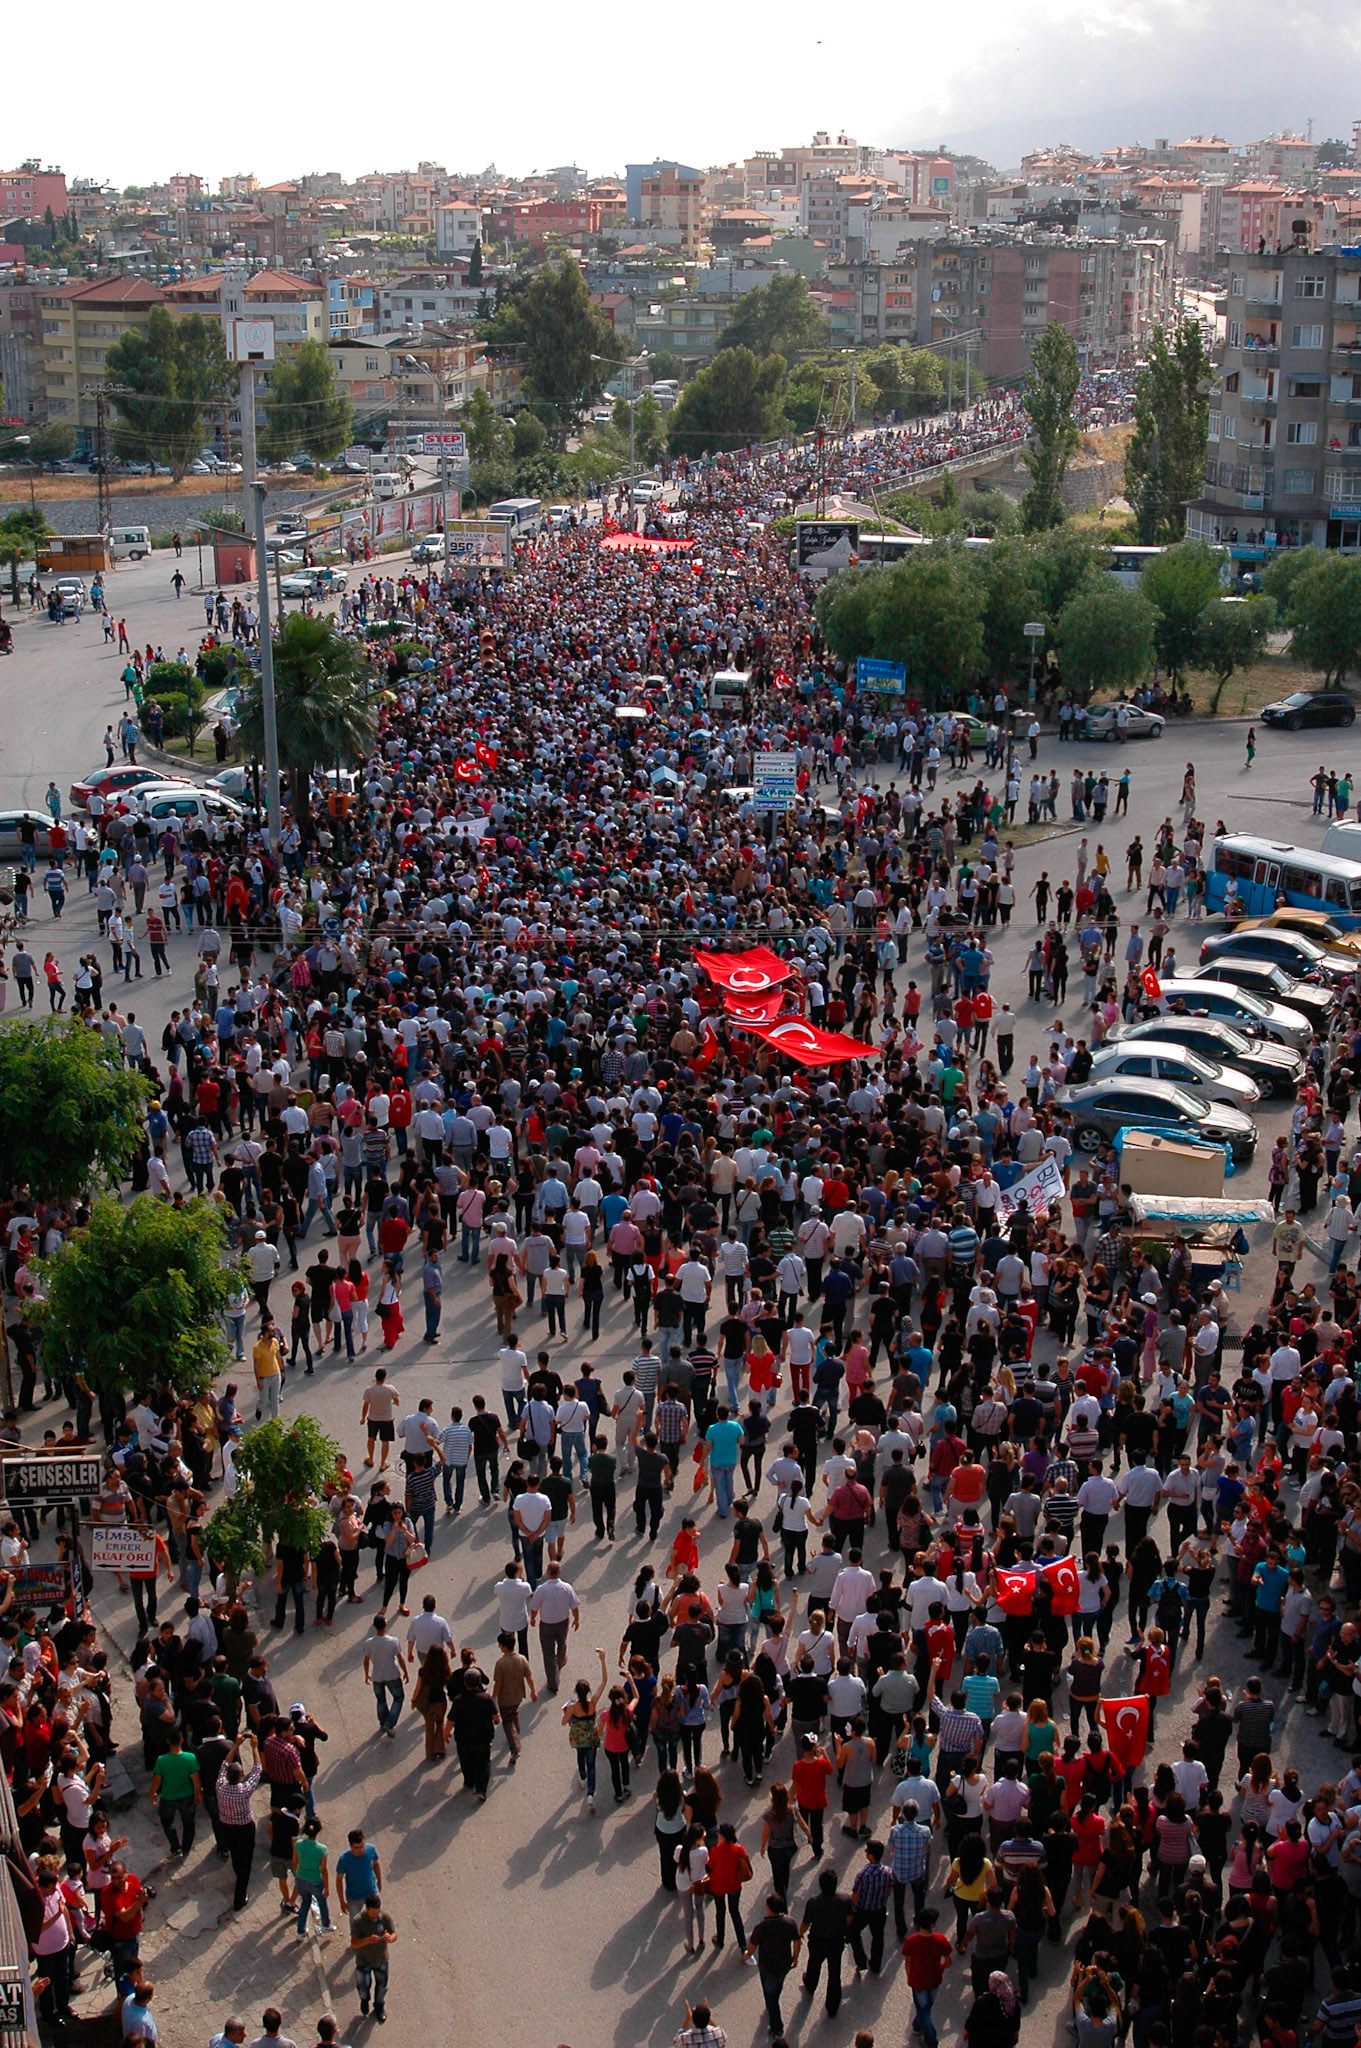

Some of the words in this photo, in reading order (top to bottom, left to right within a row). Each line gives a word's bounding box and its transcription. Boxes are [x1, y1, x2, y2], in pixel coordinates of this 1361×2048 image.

[426, 434, 461, 443] STEP
[19, 1463, 98, 1493] ŞENSESLER
[105, 1543, 141, 1551] ERKEK
[93, 1551, 153, 1561] KUAFÖRÜ
